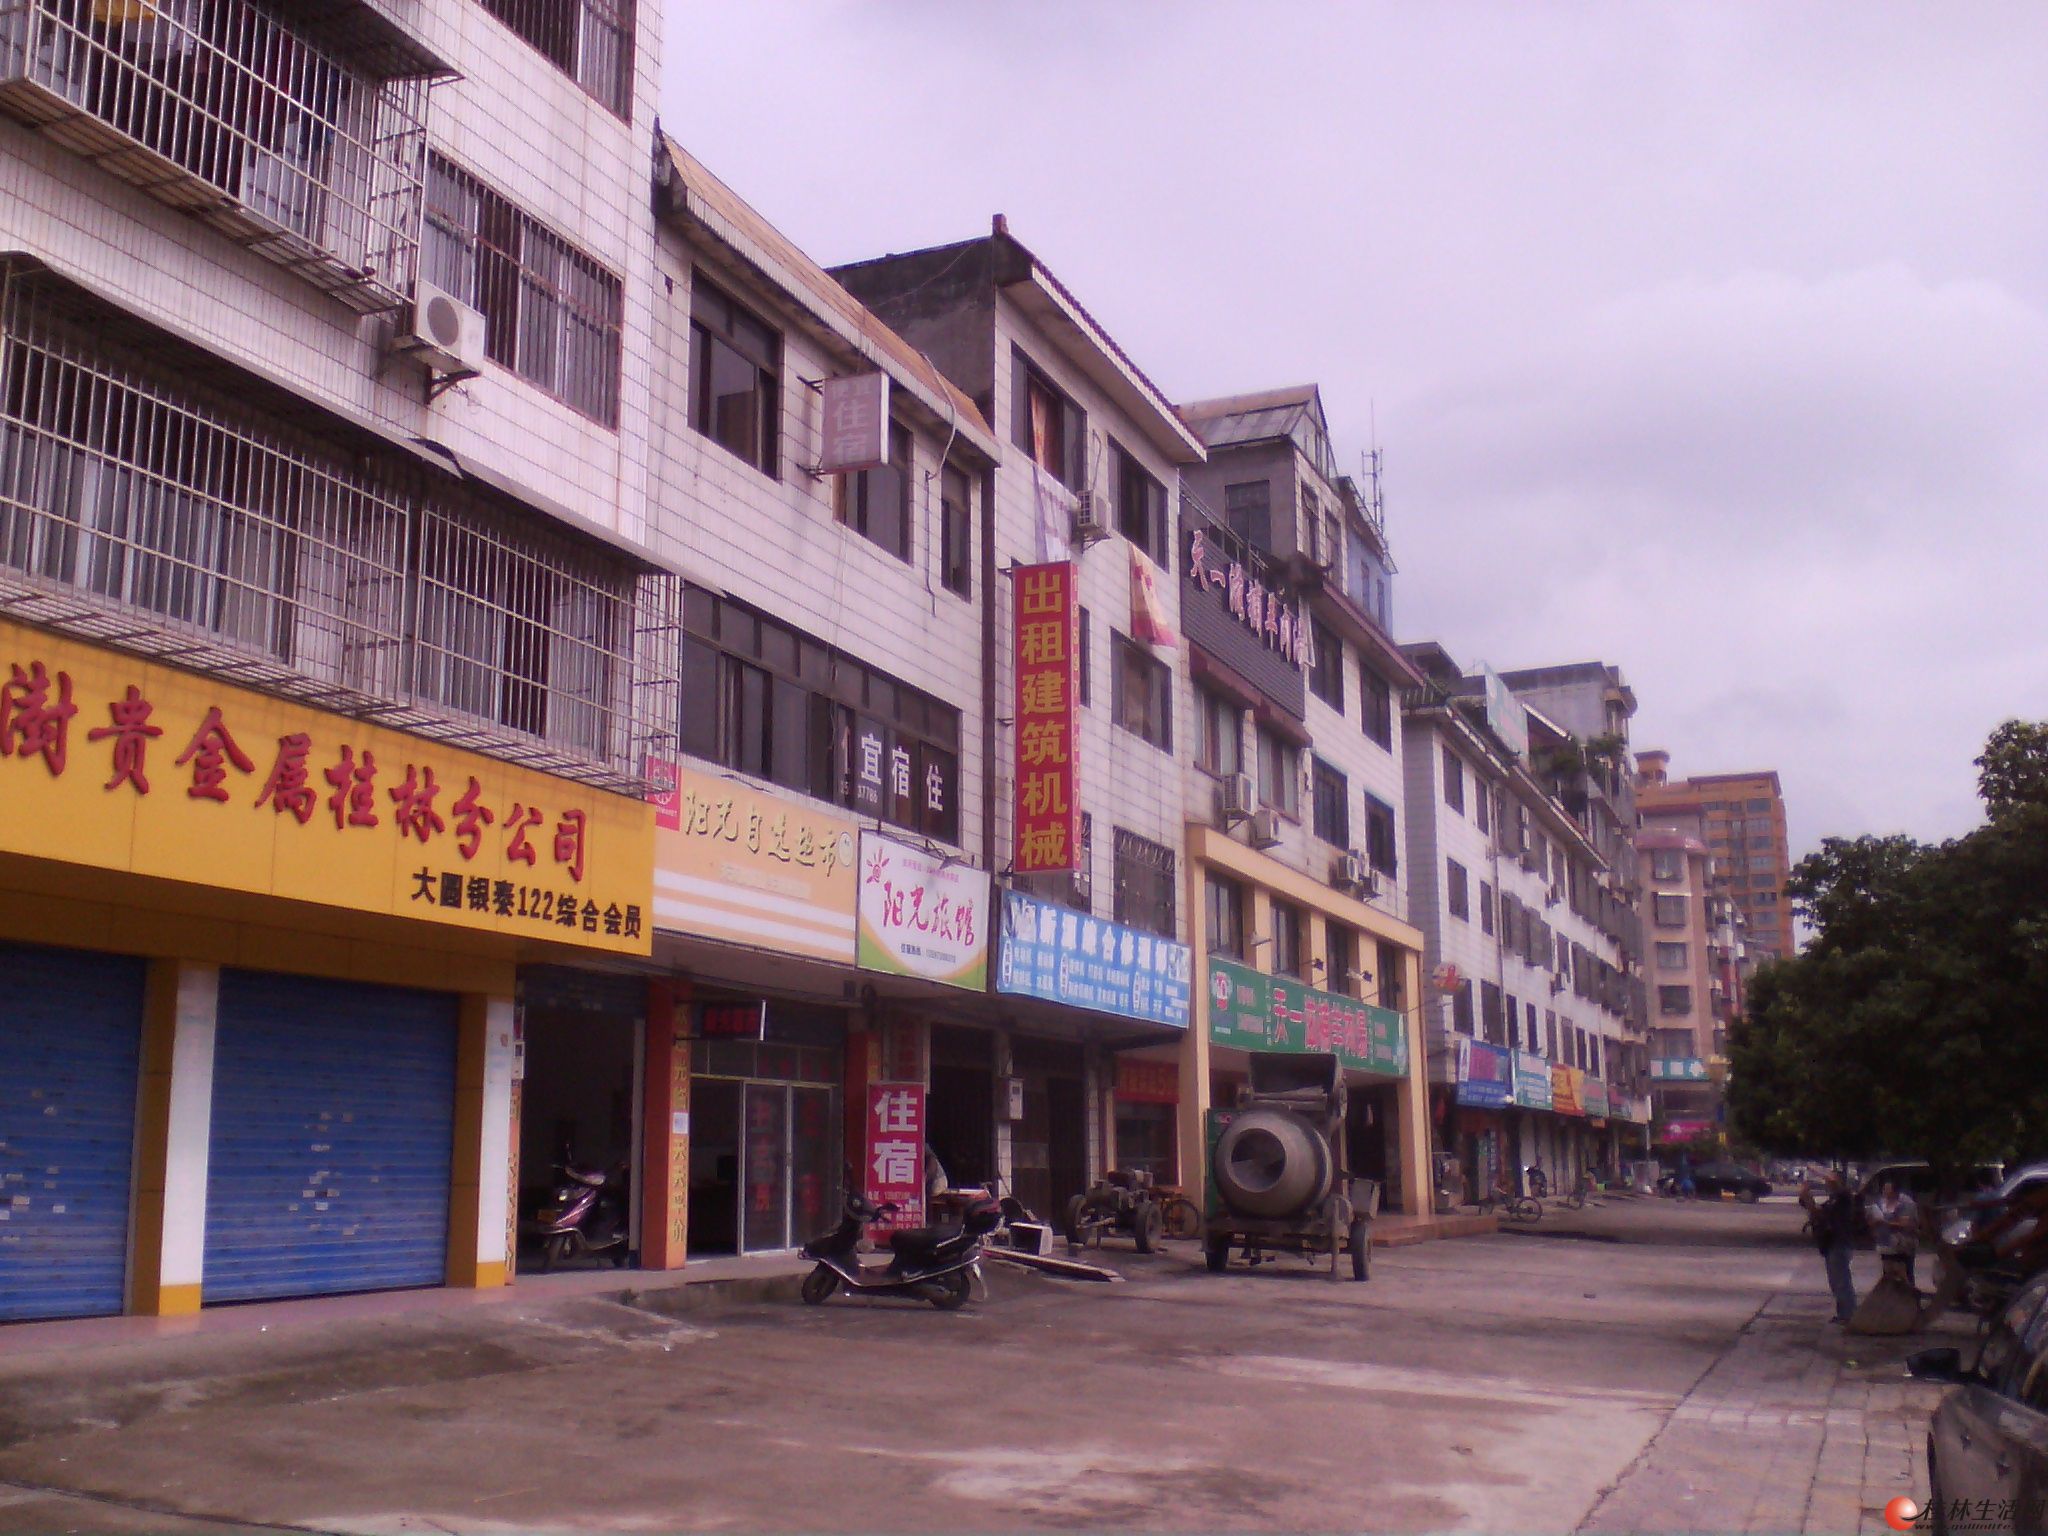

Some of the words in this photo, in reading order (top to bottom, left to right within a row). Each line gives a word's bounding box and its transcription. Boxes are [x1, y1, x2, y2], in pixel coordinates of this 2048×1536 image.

[1020, 570, 1067, 868] 出租建筑机械
[883, 879, 975, 946] 阳光旅馆
[872, 1090, 919, 1185] 住宿
